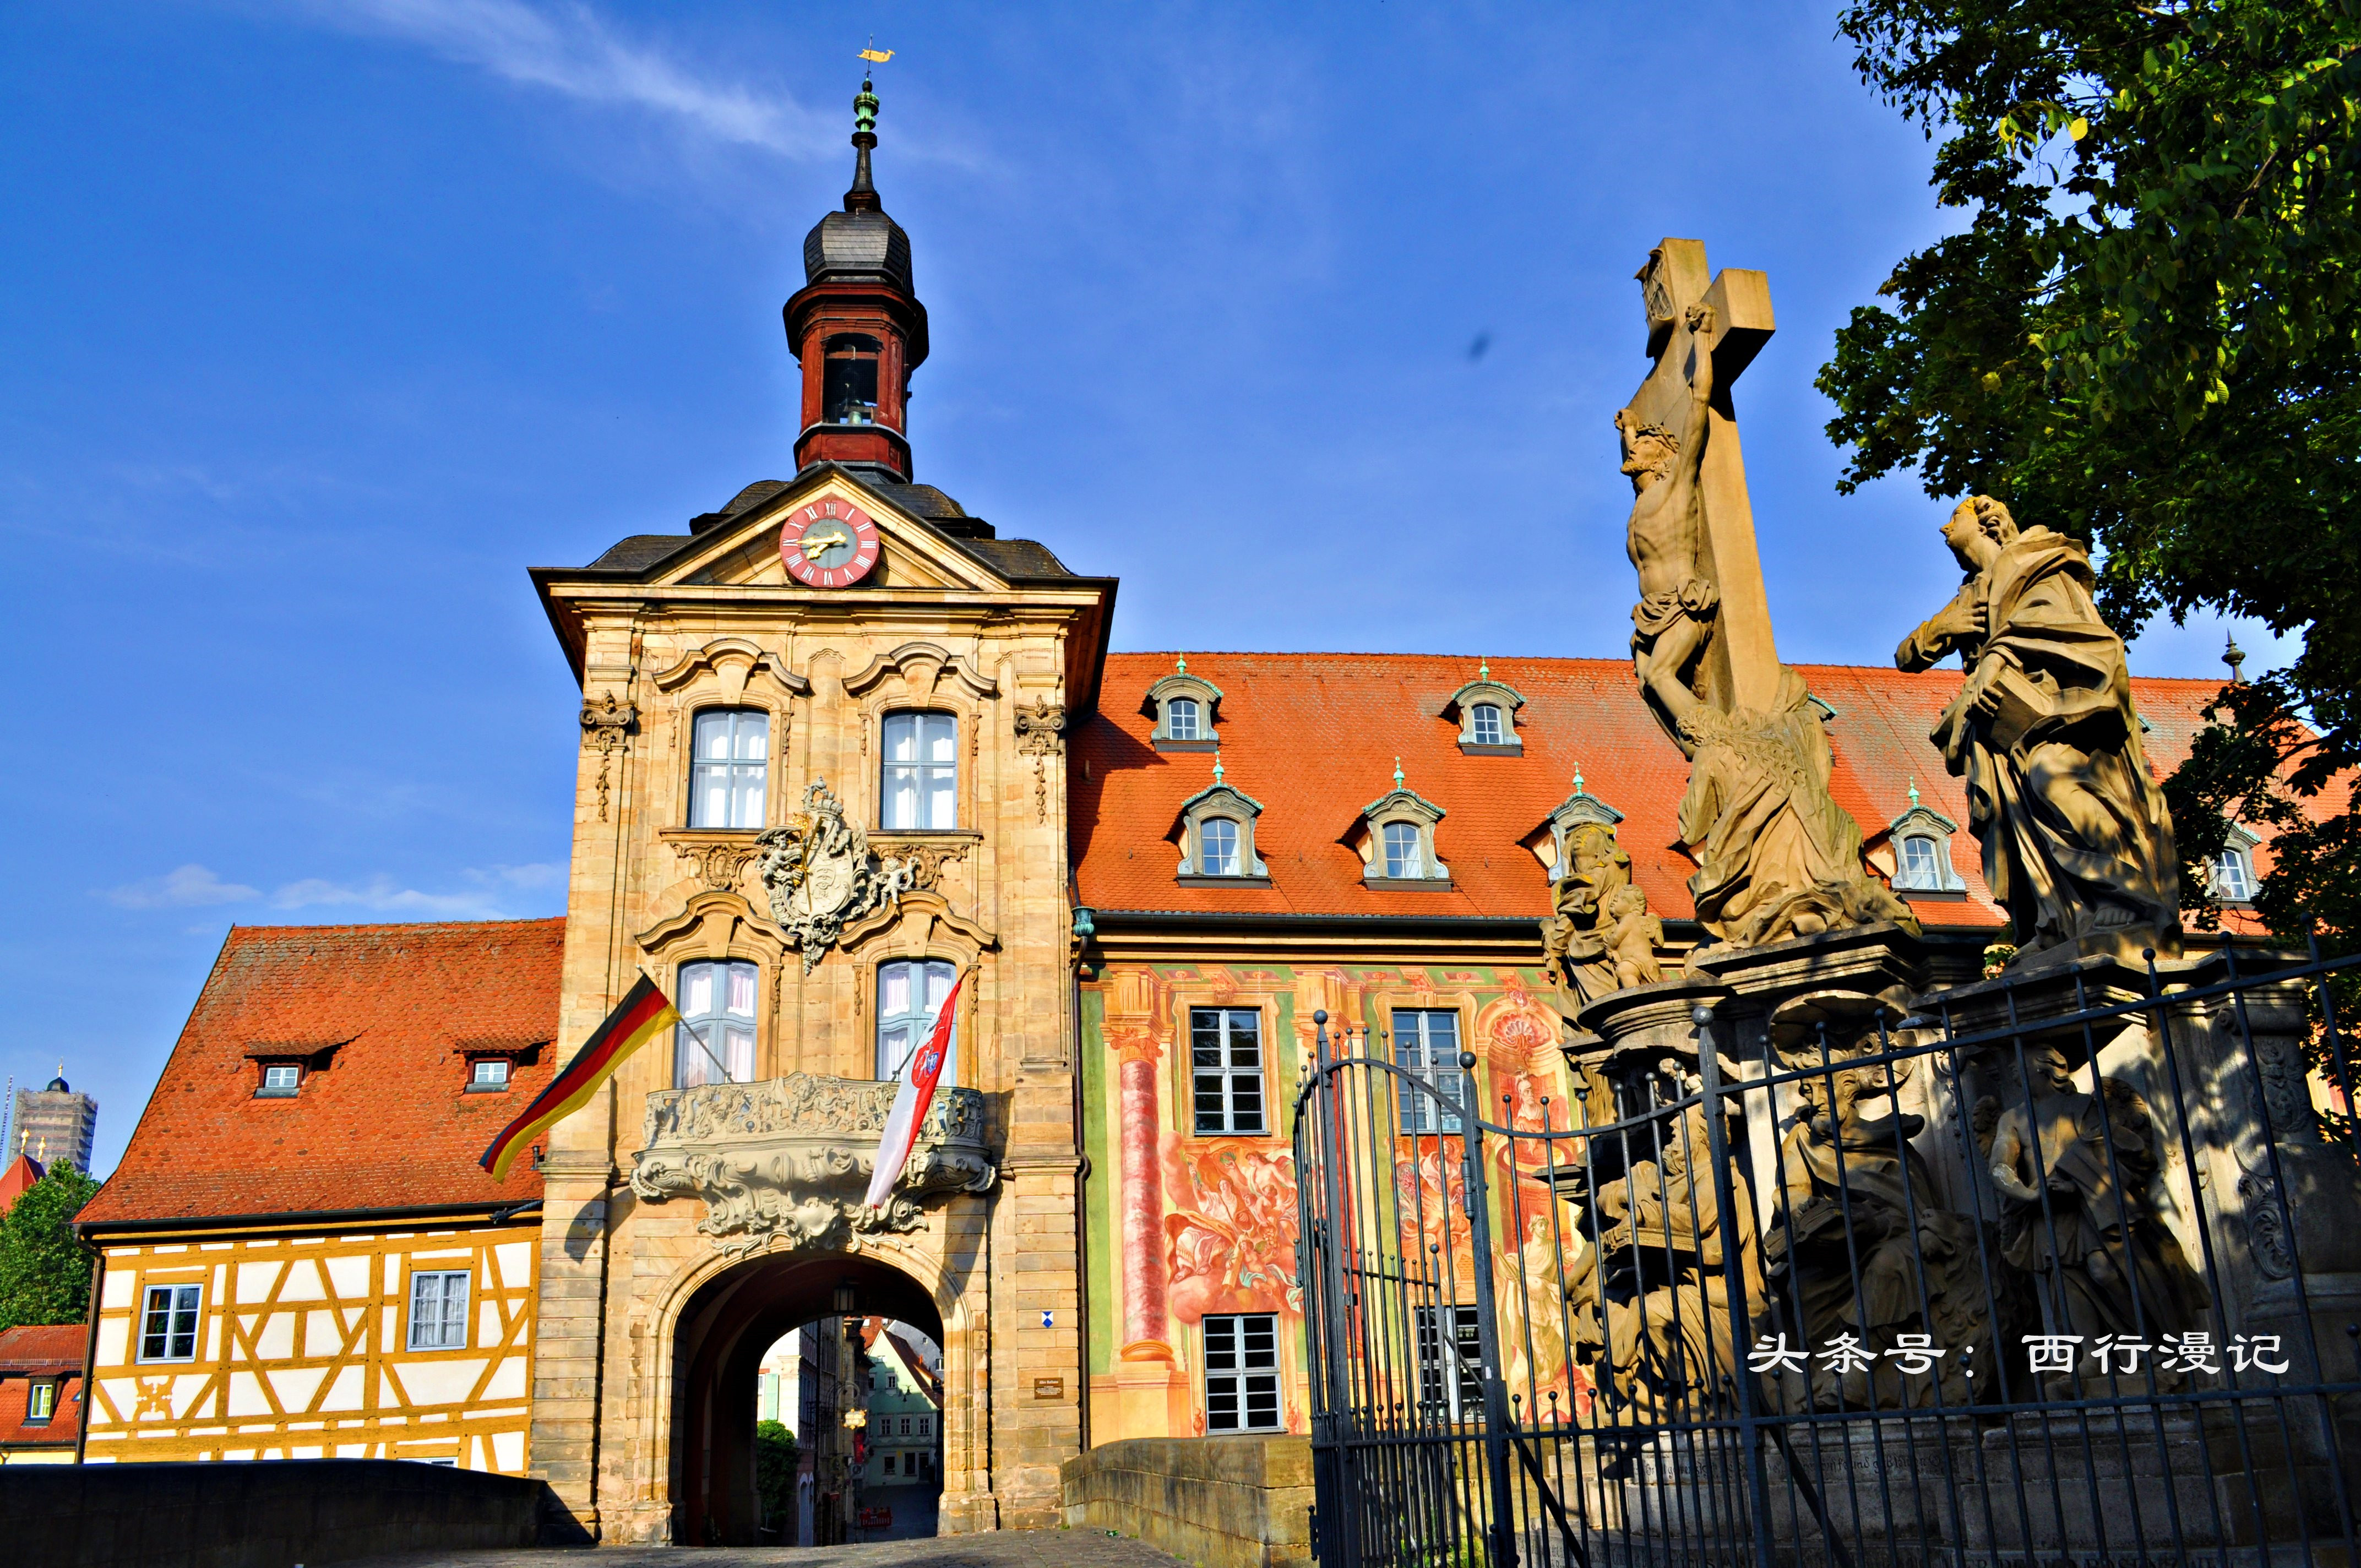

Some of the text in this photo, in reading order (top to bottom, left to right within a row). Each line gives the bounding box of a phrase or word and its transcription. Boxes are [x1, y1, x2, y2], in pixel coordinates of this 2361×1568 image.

[804, 506, 818, 521] XI
[825, 503, 836, 516] XII
[845, 508, 855, 521] I
[788, 519, 804, 532] X
[856, 521, 872, 533] II
[861, 540, 876, 548] III
[854, 554, 872, 569] IIII
[824, 571, 833, 585] VI
[844, 568, 855, 581] V
